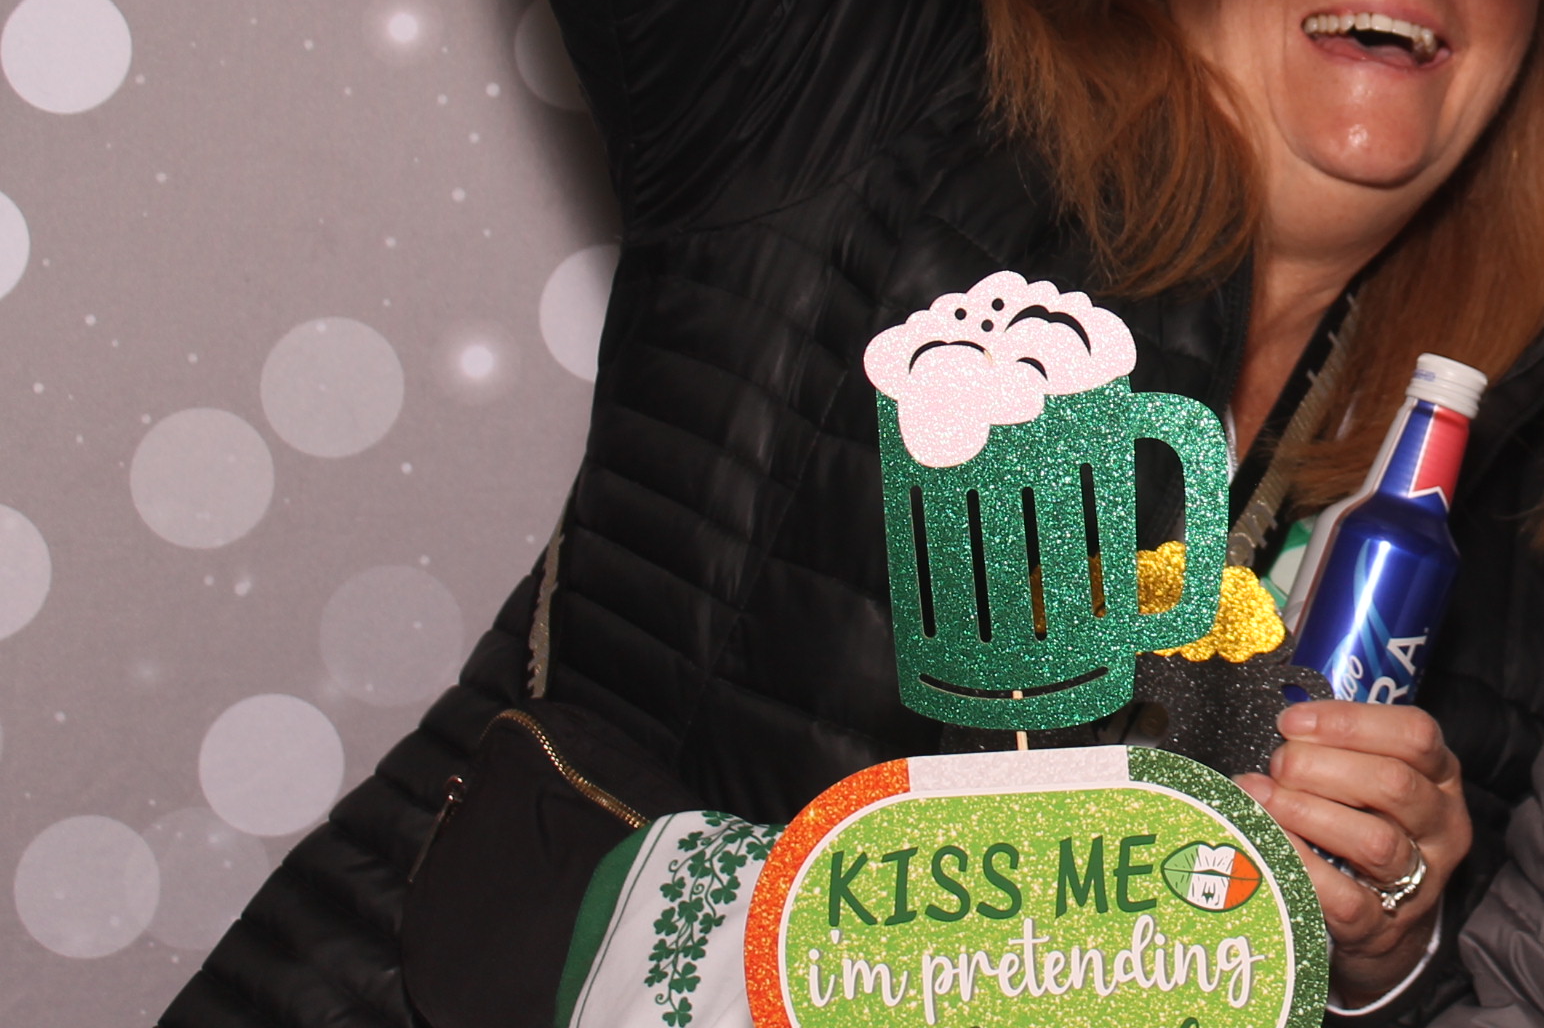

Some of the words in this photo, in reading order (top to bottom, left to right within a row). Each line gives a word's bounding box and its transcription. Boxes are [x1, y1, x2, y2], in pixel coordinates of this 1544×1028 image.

[827, 841, 1022, 928] KISS
[1055, 833, 1158, 919] ME
[806, 928, 907, 1007] i'm
[922, 915, 1265, 1025] pretending
